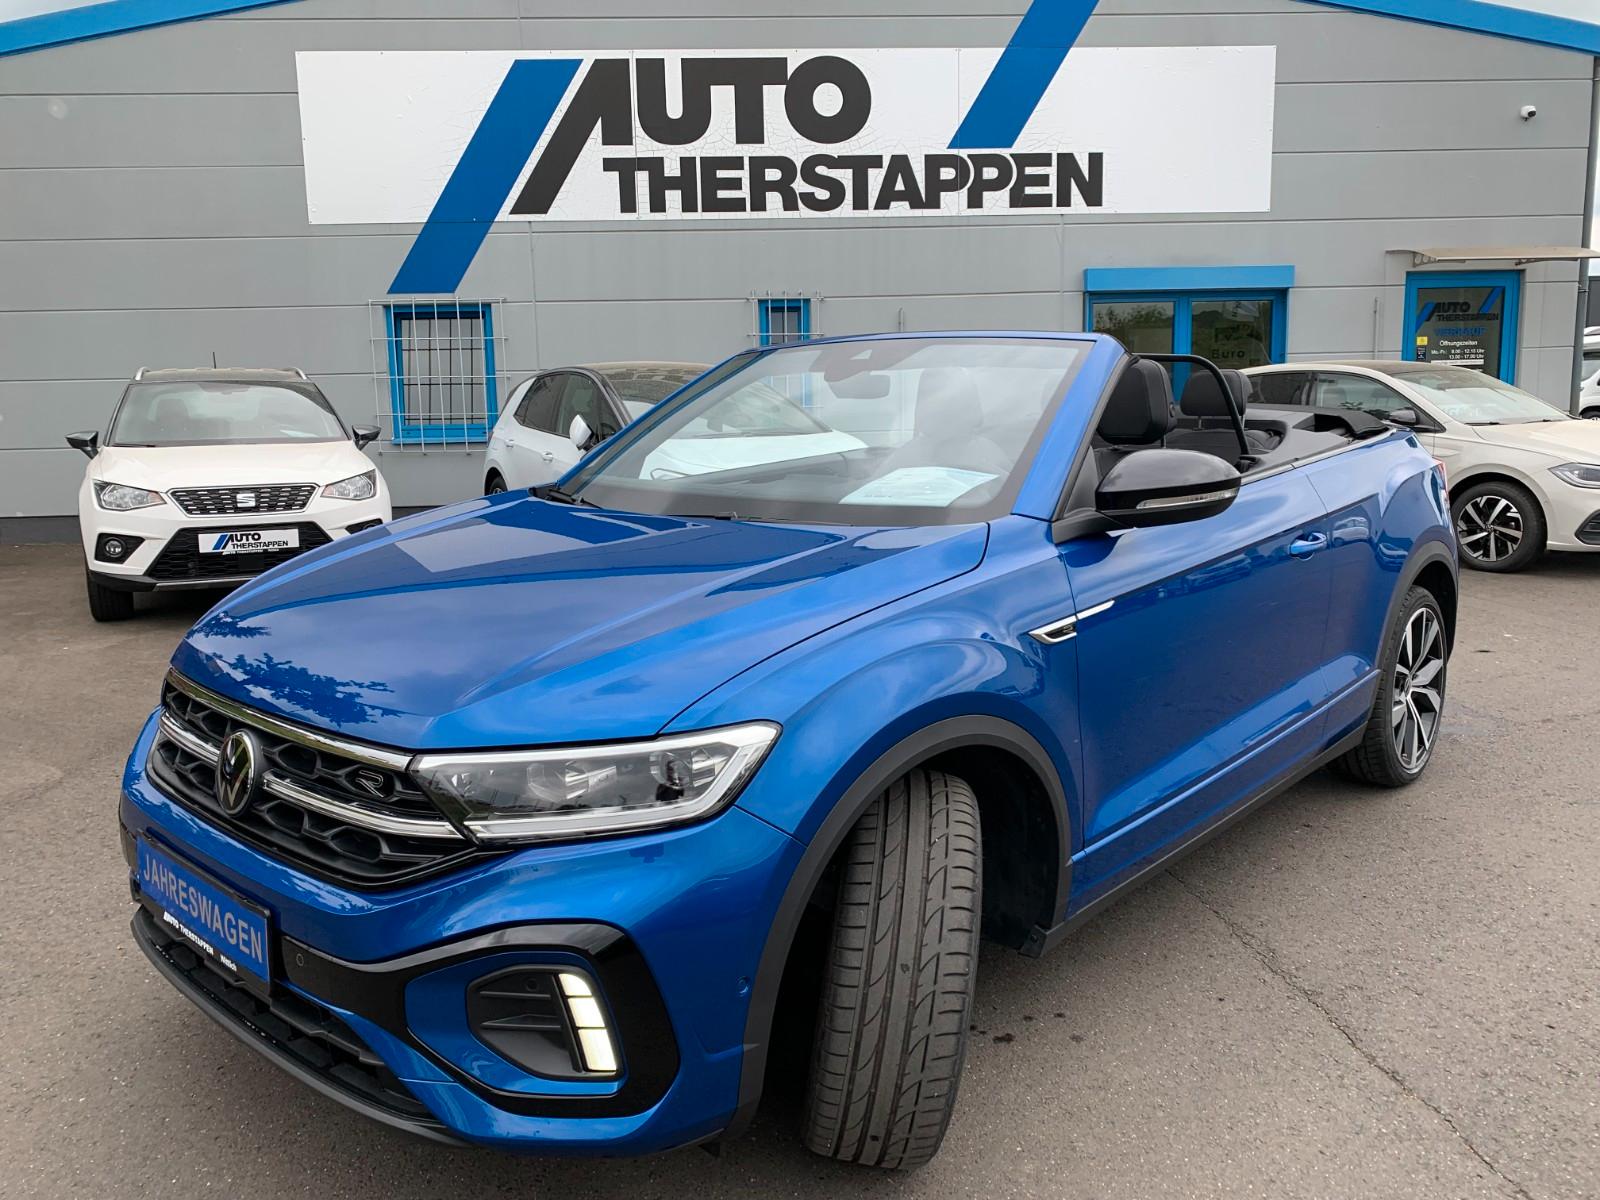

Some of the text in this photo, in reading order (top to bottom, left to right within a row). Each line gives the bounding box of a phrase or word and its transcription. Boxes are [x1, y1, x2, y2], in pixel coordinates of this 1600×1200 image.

[509, 56, 871, 215] AUTO
[602, 152, 1104, 216] THERSTAPPEN
[1424, 301, 1470, 322] AUTO
[220, 532, 261, 550] AUTO
[231, 540, 288, 550] THERSTAPPEN
[143, 854, 263, 964] JAHRESWAGEN
